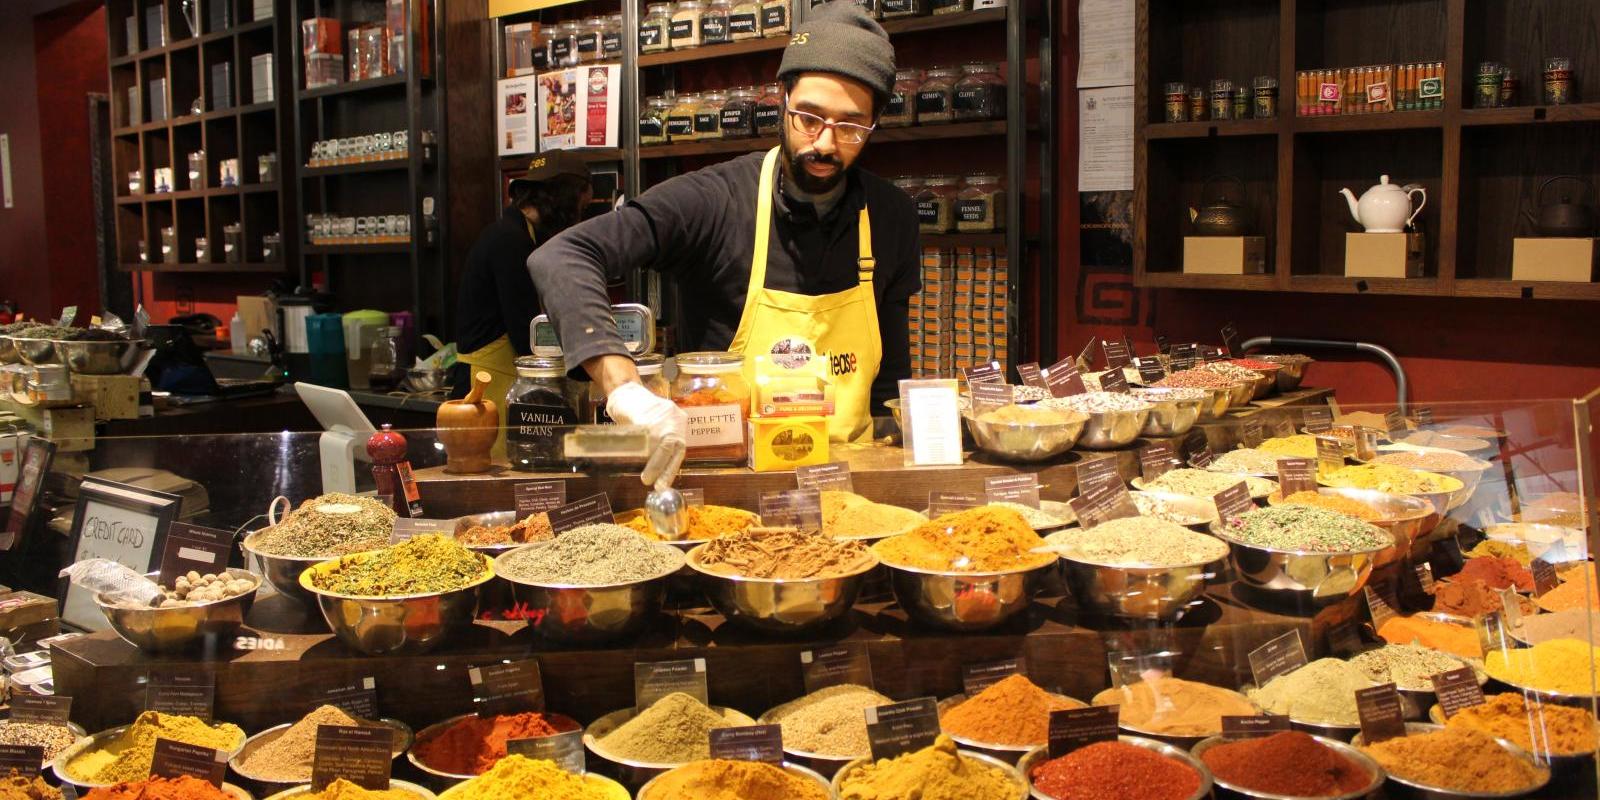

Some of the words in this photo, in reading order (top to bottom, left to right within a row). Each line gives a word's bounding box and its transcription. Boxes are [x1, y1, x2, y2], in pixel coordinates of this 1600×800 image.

[520, 411, 564, 424] VANILLA
[519, 425, 553, 437] BEANS
[691, 427, 721, 436] PEPPER
[83, 516, 122, 541] CREDIT
[117, 526, 145, 549] CARD
